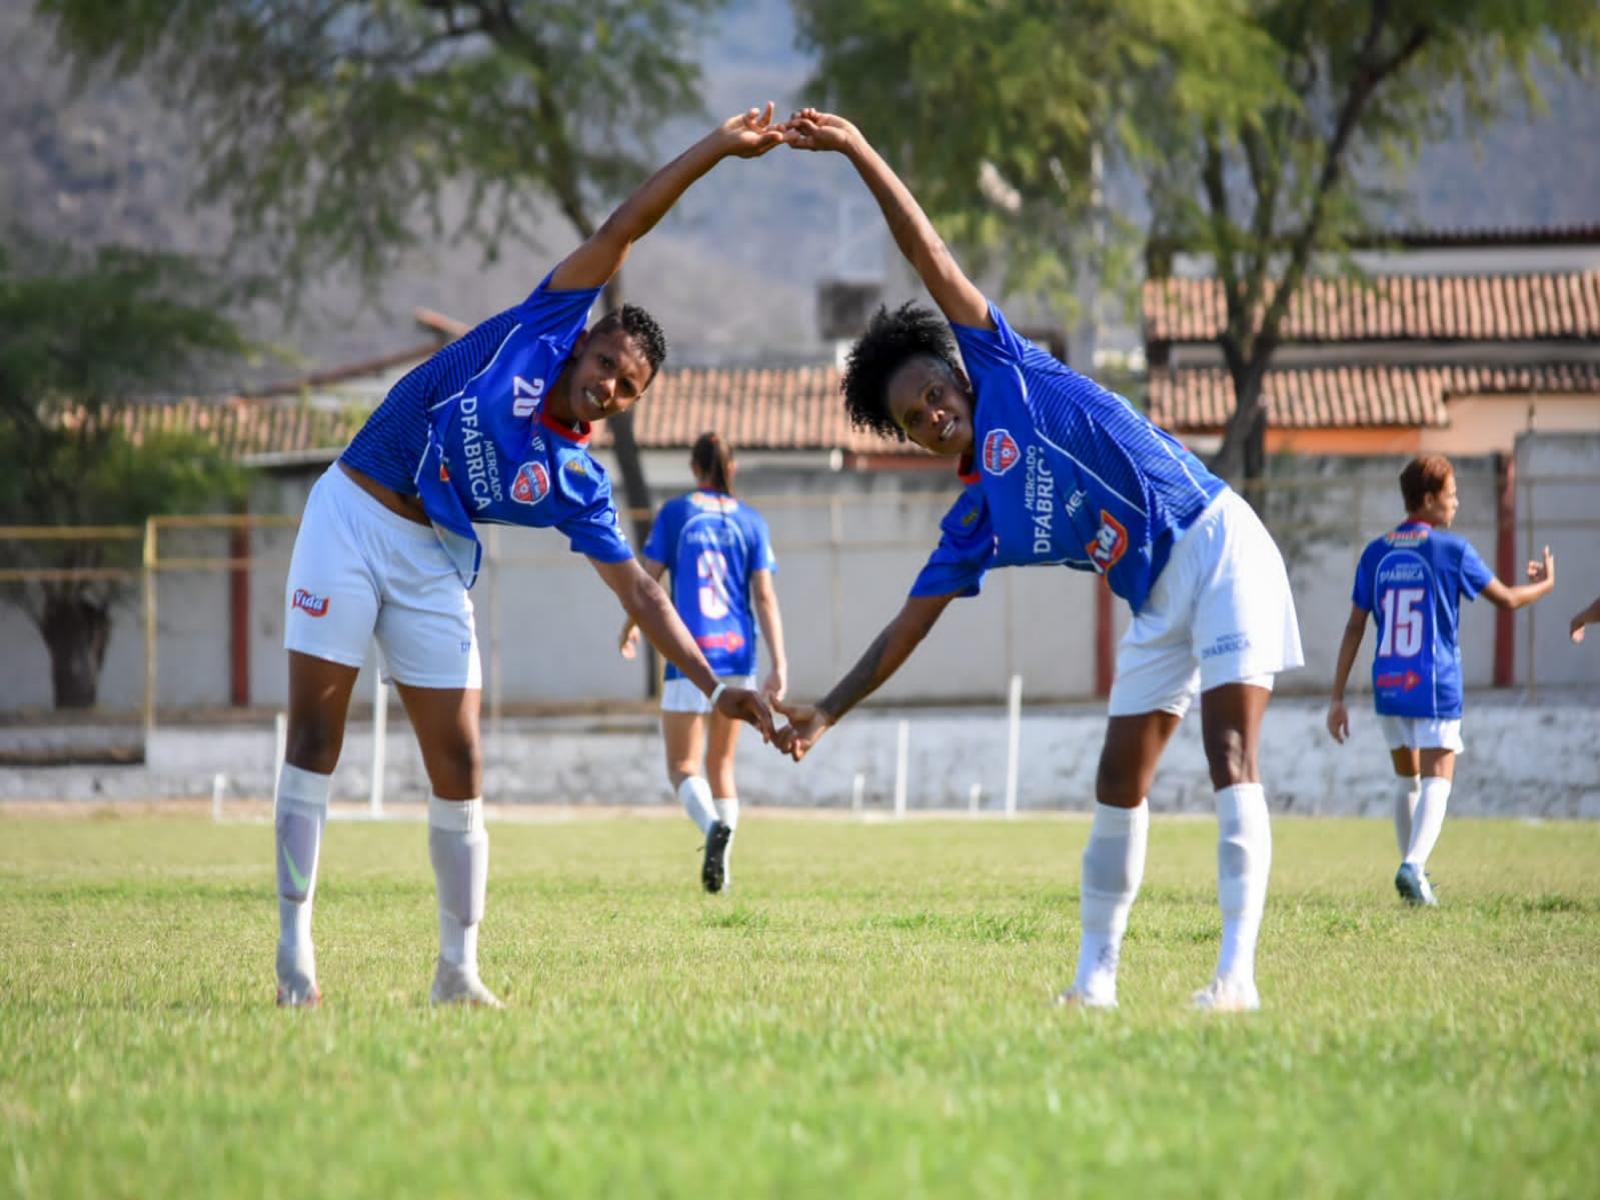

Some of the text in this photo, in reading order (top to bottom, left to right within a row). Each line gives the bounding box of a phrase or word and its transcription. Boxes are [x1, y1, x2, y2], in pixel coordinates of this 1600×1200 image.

[460, 396, 492, 510] DFÁBRICA
[484, 440, 503, 501] MERCADO
[1024, 445, 1037, 510] MERCADO
[1031, 447, 1054, 554] DFÁBRIC
[1379, 588, 1425, 658] 15
